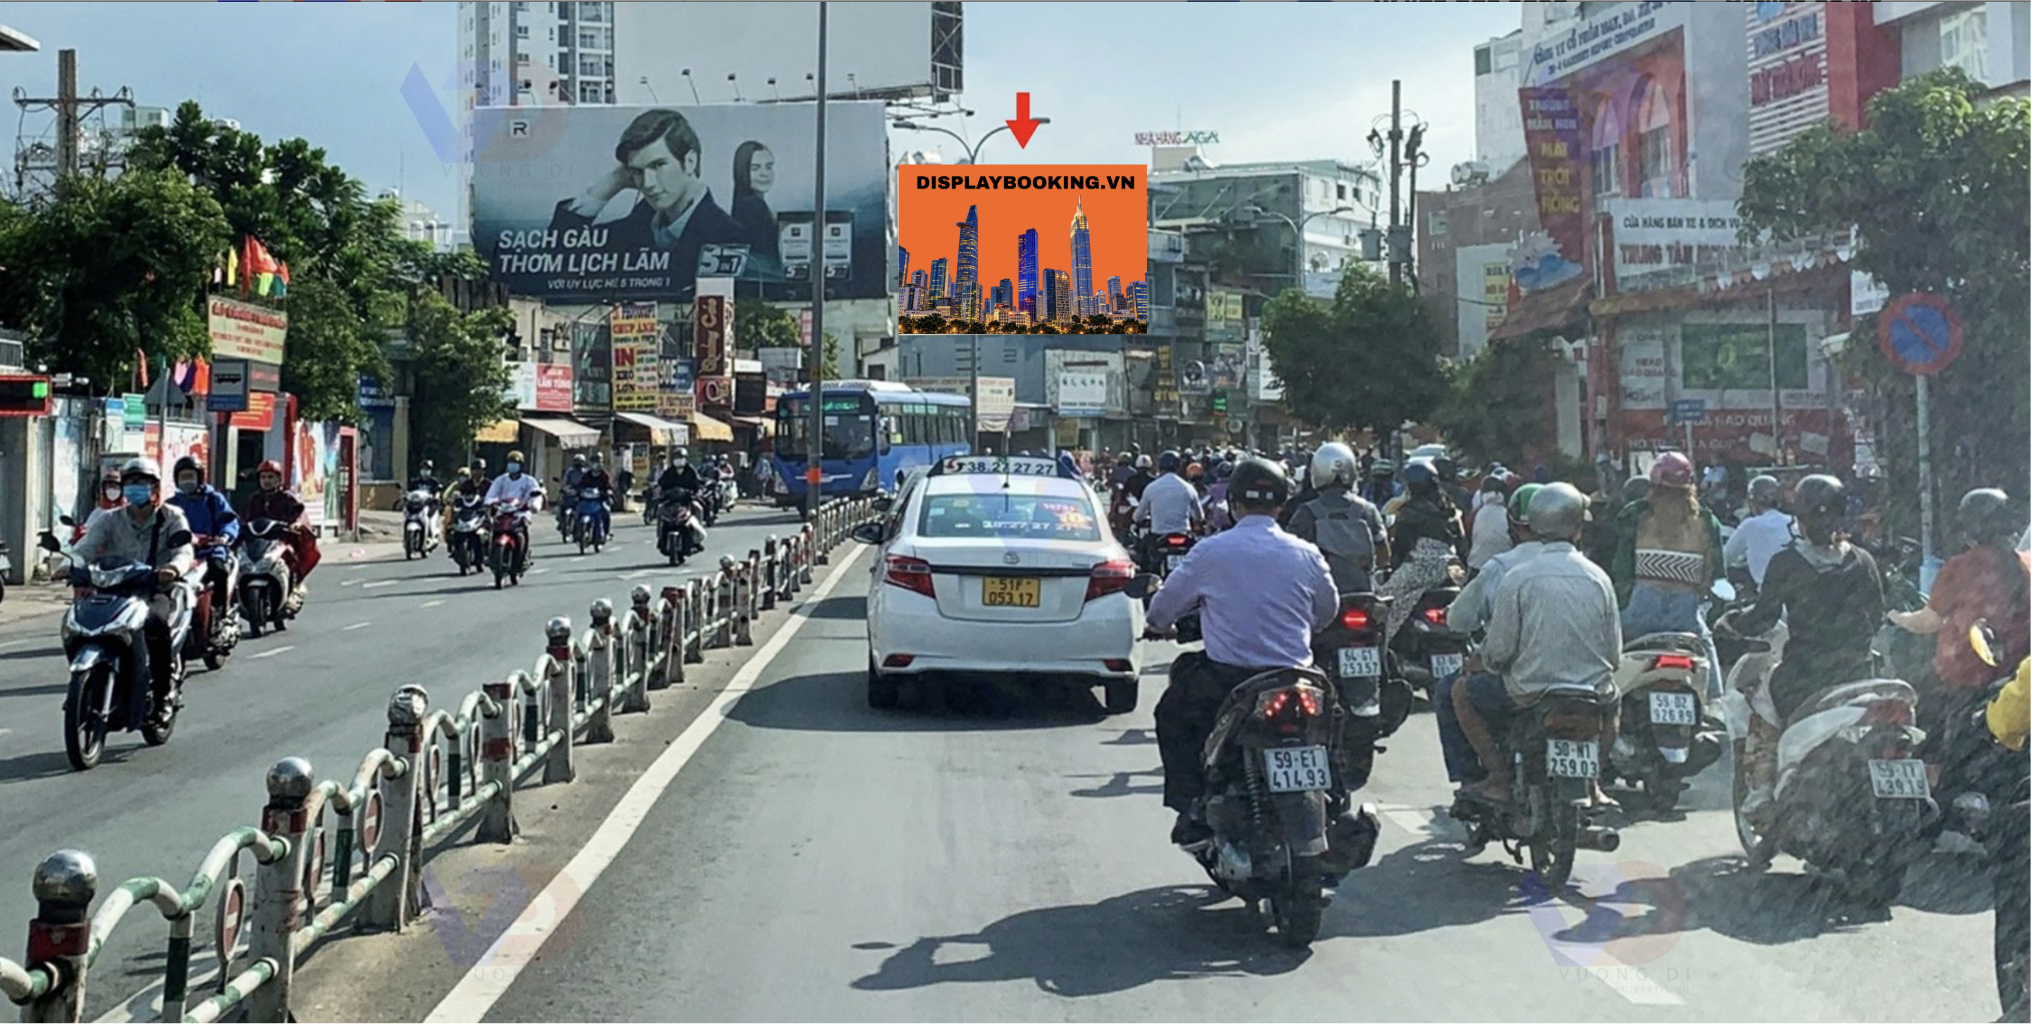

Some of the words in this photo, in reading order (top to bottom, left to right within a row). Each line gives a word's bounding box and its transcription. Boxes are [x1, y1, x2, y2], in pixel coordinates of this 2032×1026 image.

[499, 229, 558, 252] SẠCH
[563, 225, 608, 248] GÀU
[500, 253, 567, 273] THƠM
[568, 252, 618, 276] LỊCH
[623, 248, 670, 272] LÃM
[620, 279, 627, 288] 5
[665, 277, 671, 287] 1
[615, 348, 634, 366] IN
[967, 461, 1008, 474] 38.27
[1013, 462, 1031, 474] 27
[1035, 463, 1053, 475] 27
[1000, 578, 1022, 591] 51F
[989, 591, 1033, 606] 053.17
[1275, 751, 1317, 768] 59-E1
[1551, 759, 1597, 777] 259.03
[1273, 769, 1326, 790] 414.93
